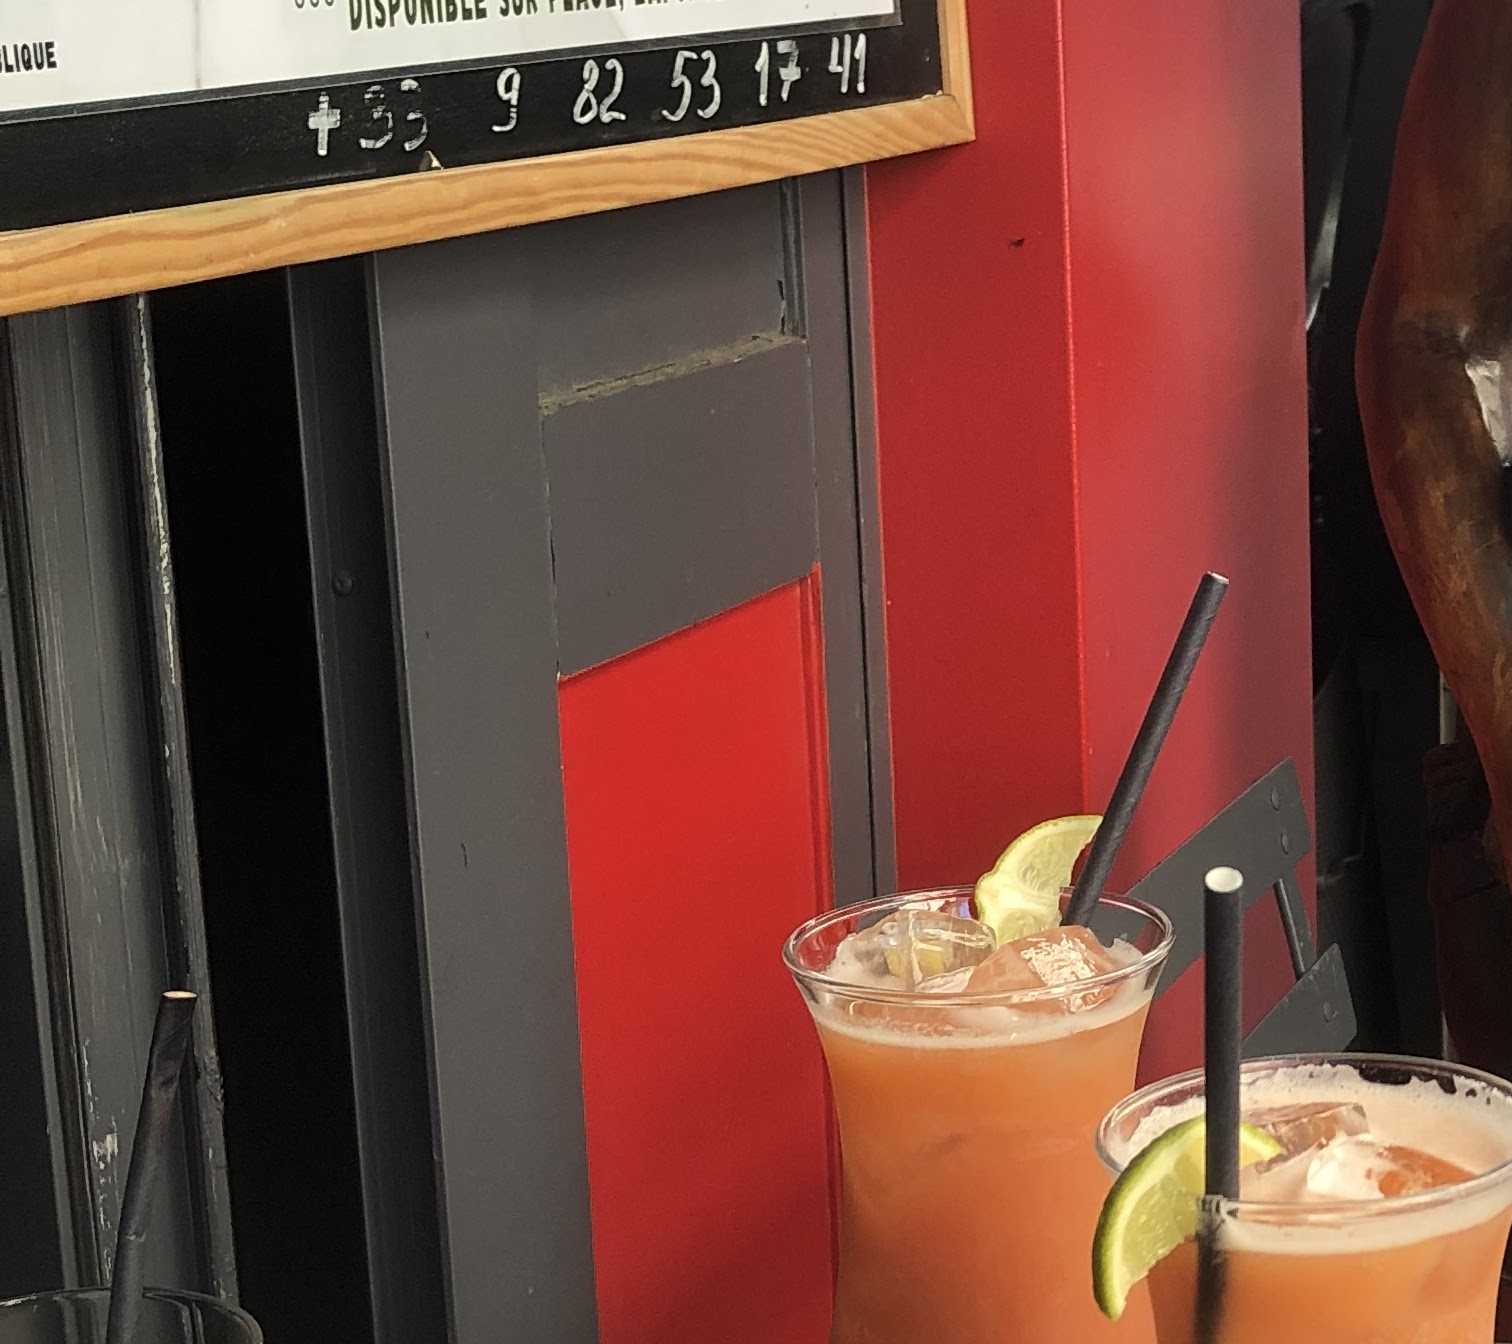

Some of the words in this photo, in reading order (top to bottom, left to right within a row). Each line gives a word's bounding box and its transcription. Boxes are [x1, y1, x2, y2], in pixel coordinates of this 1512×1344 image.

[490, 66, 523, 134] 9
[572, 57, 629, 126] 82
[661, 49, 724, 123] 53
[754, 39, 801, 107] 17
